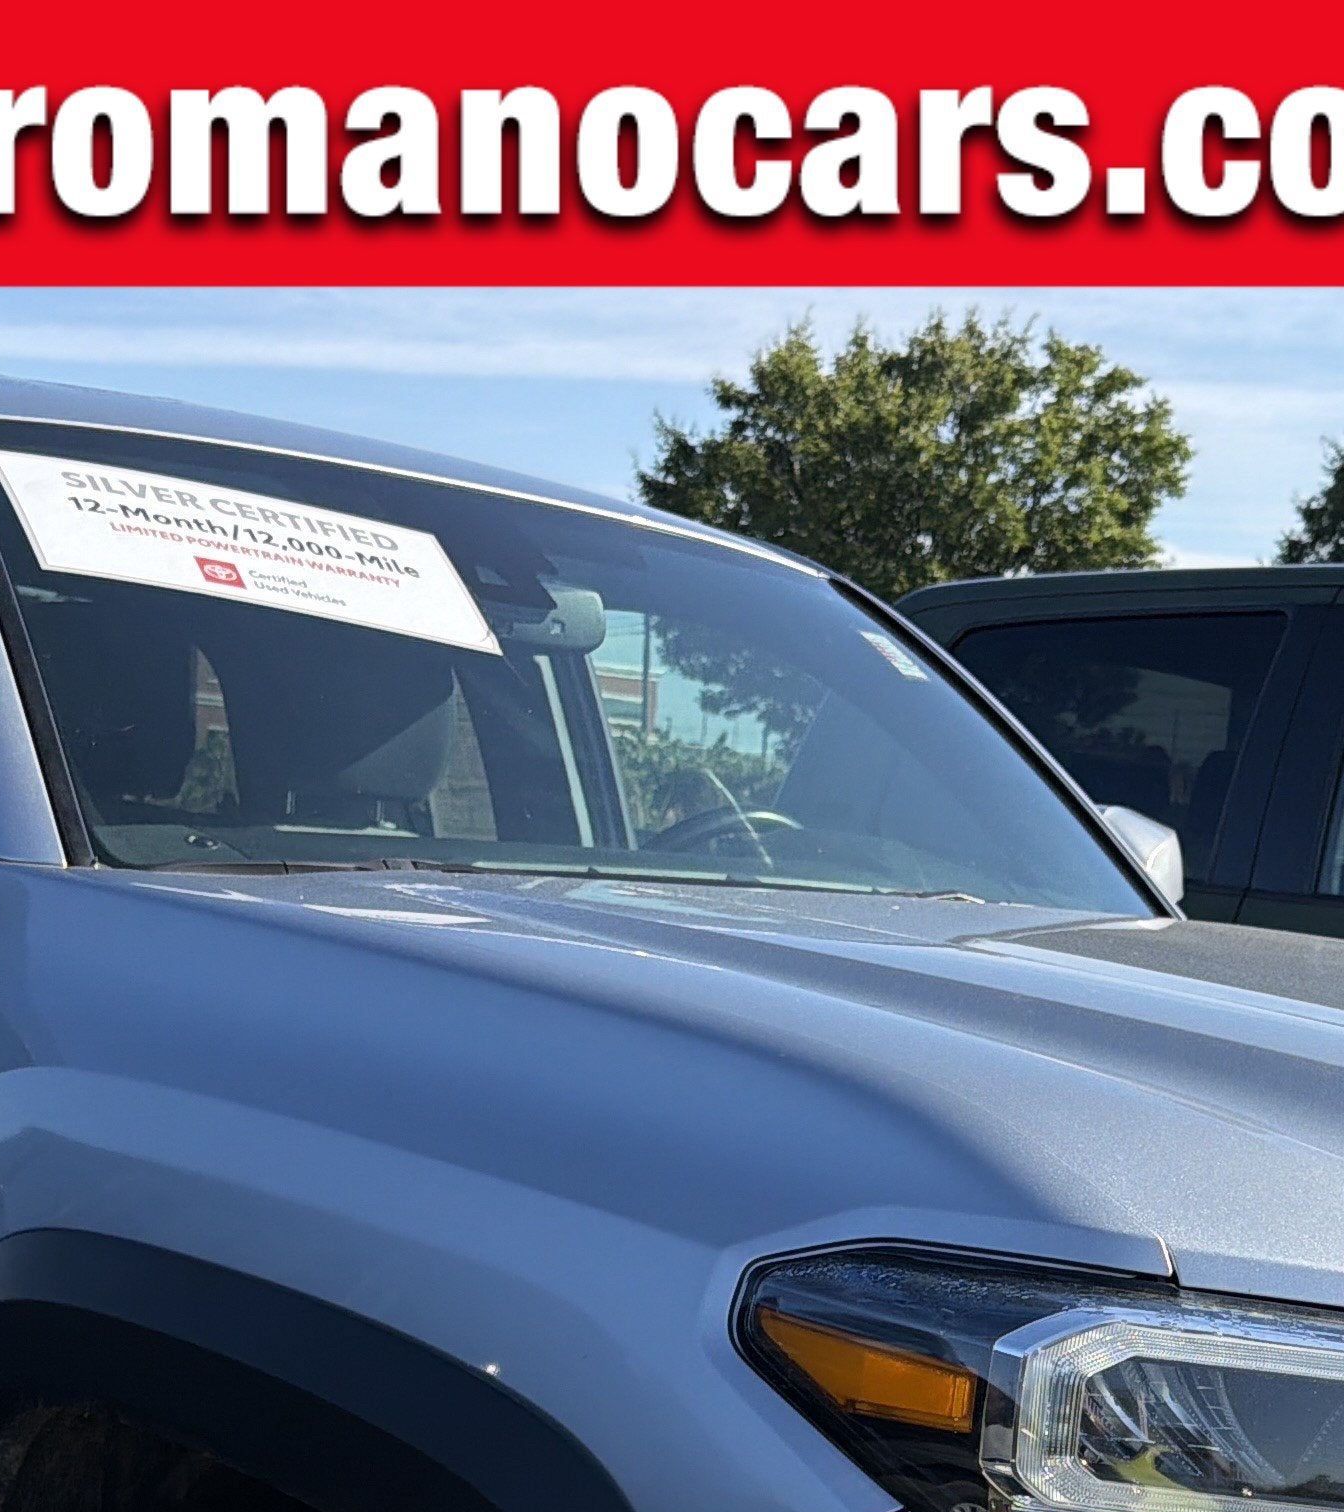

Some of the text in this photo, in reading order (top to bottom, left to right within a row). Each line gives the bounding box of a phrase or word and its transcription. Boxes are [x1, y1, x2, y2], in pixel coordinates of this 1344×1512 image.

[61, 471, 399, 551] SILVER CERTIFIED
[109, 521, 400, 588] LIMITED POWERTRAIN WARRANTY
[248, 569, 308, 588] Certified
[254, 581, 290, 595] Used
